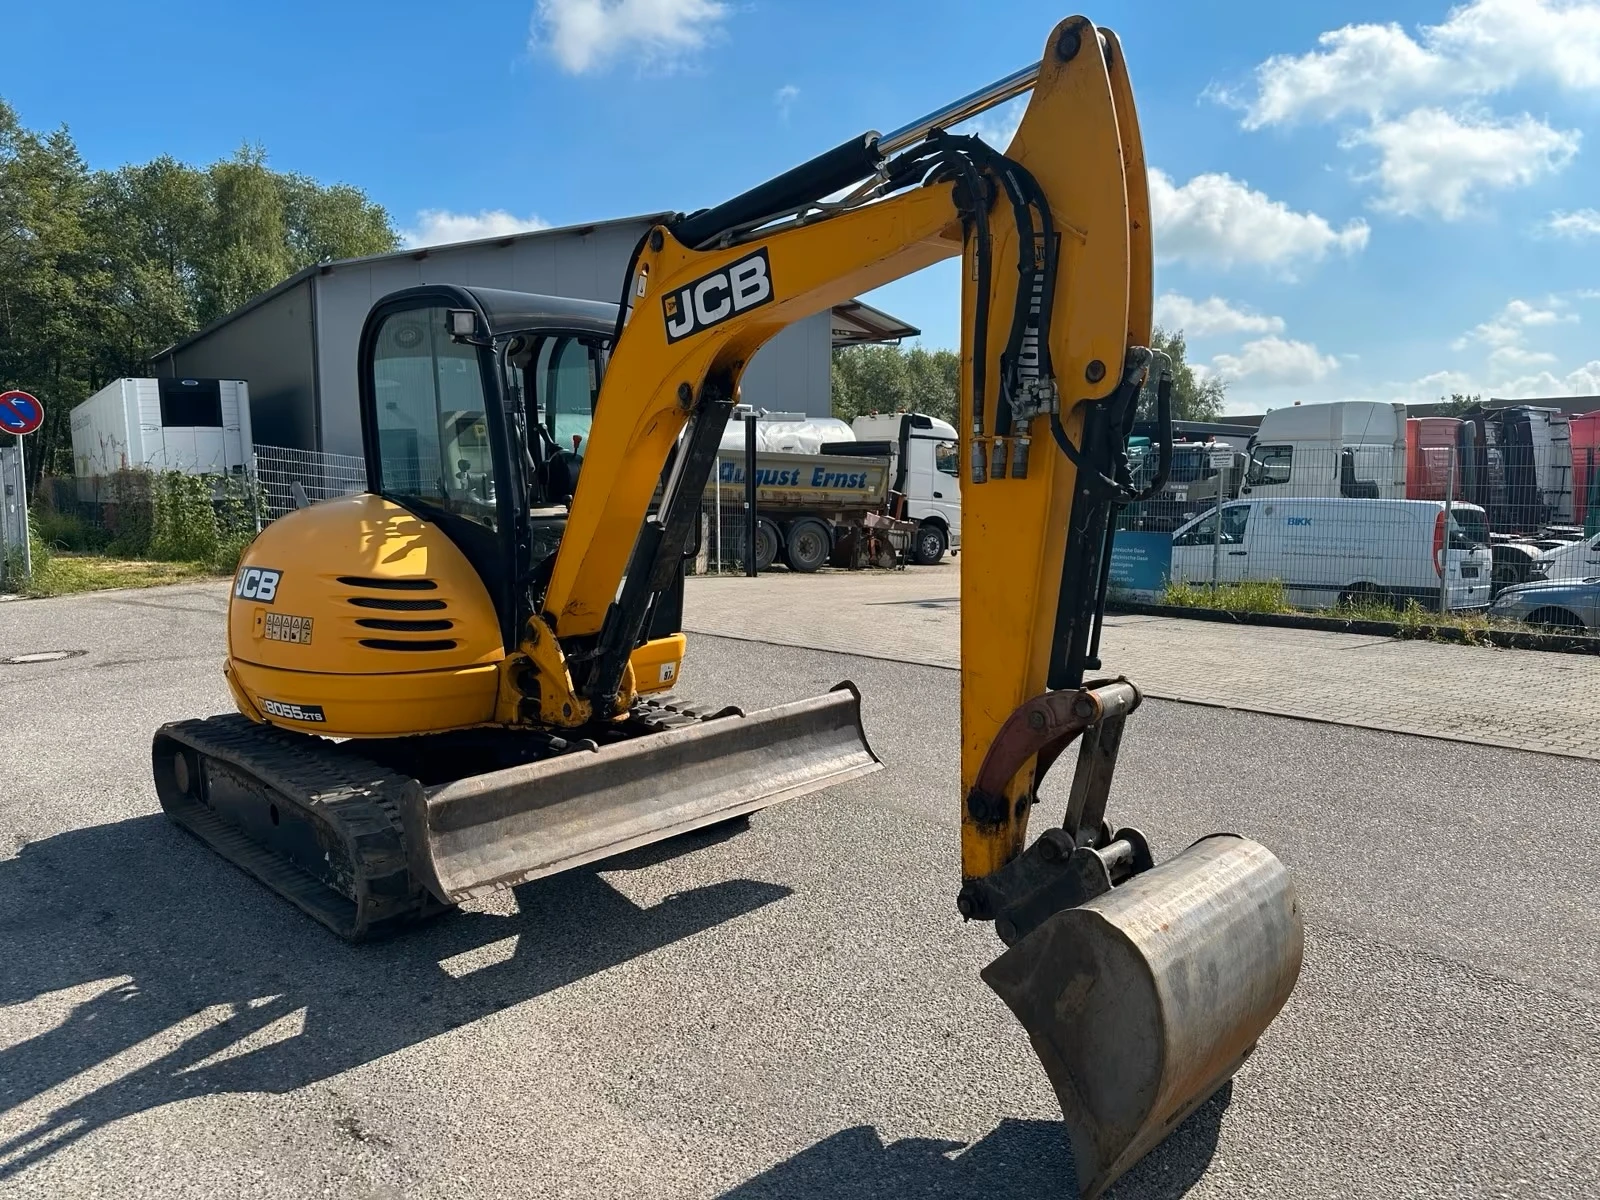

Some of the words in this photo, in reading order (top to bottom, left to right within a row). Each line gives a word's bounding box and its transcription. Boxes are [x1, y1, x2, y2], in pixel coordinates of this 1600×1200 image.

[668, 255, 770, 338] JCB
[811, 467, 868, 488] Ernst
[235, 568, 280, 601] JCB
